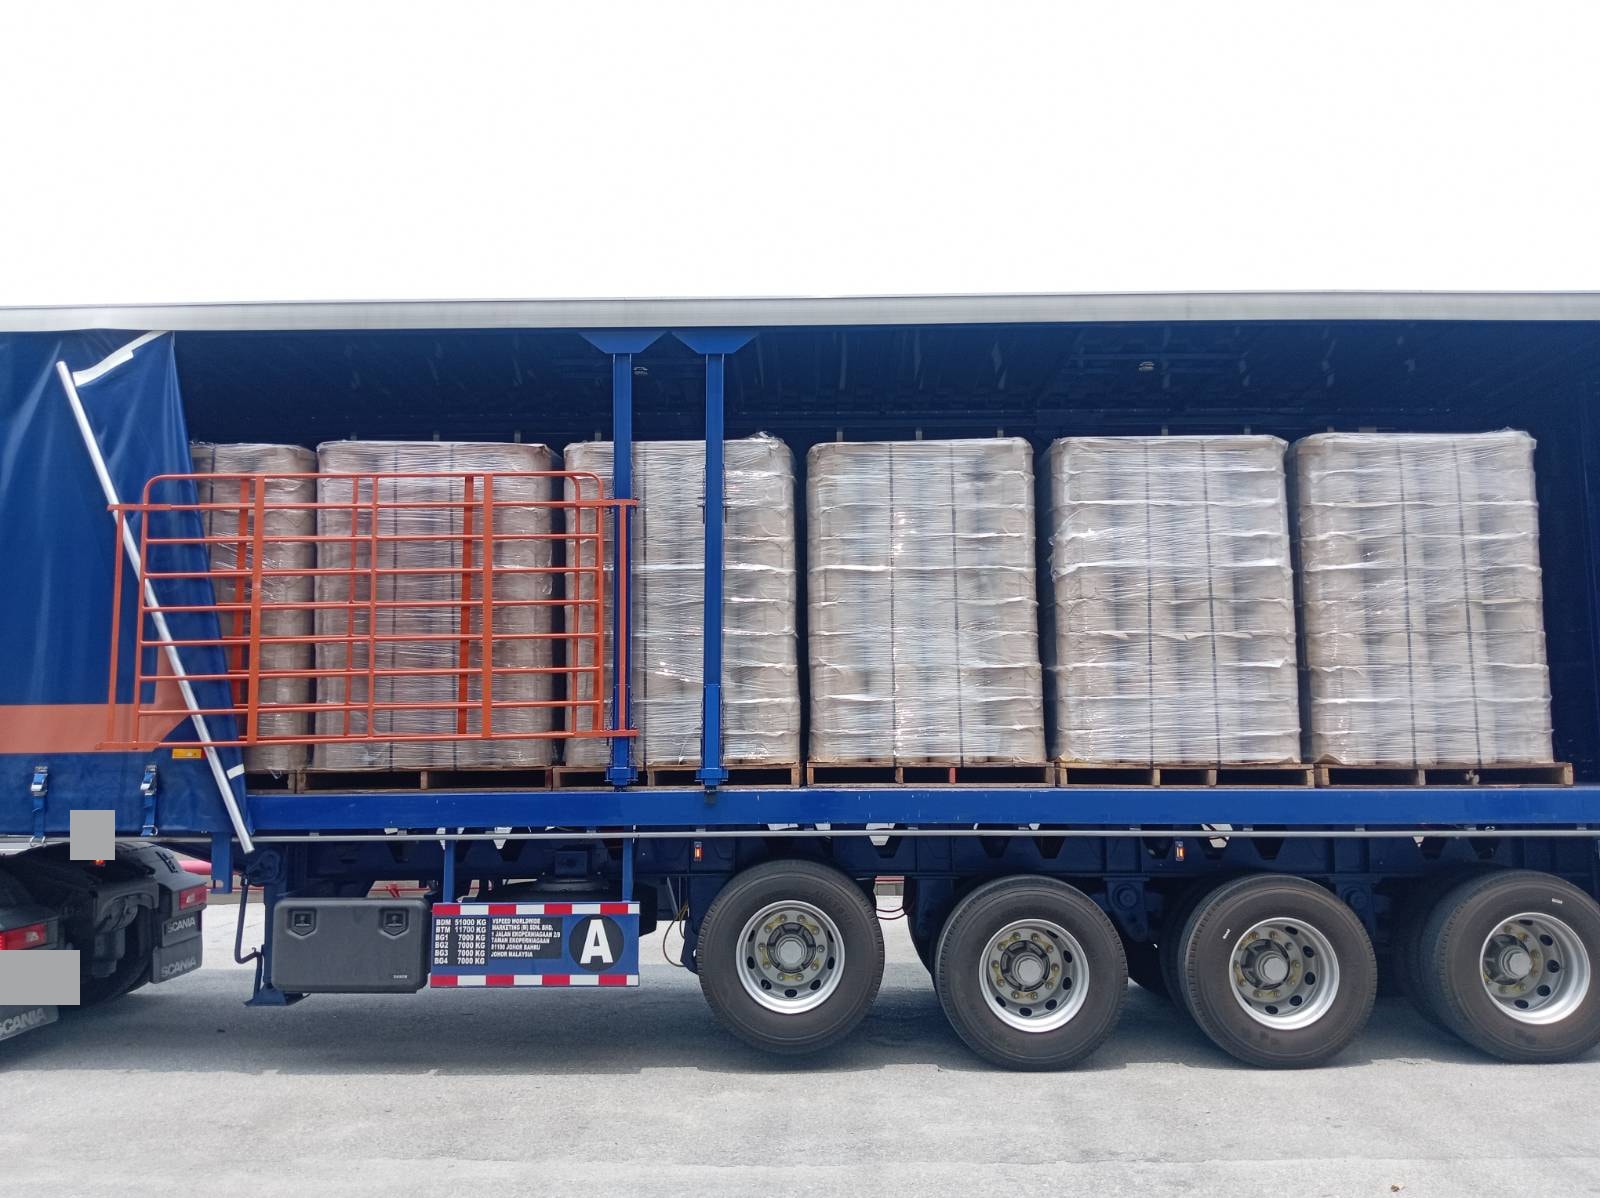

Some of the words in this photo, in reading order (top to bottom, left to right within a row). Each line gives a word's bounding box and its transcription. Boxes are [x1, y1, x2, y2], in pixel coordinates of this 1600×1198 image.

[167, 917, 196, 933] SCANIA
[580, 919, 614, 964] A
[160, 957, 197, 977] SCANIA
